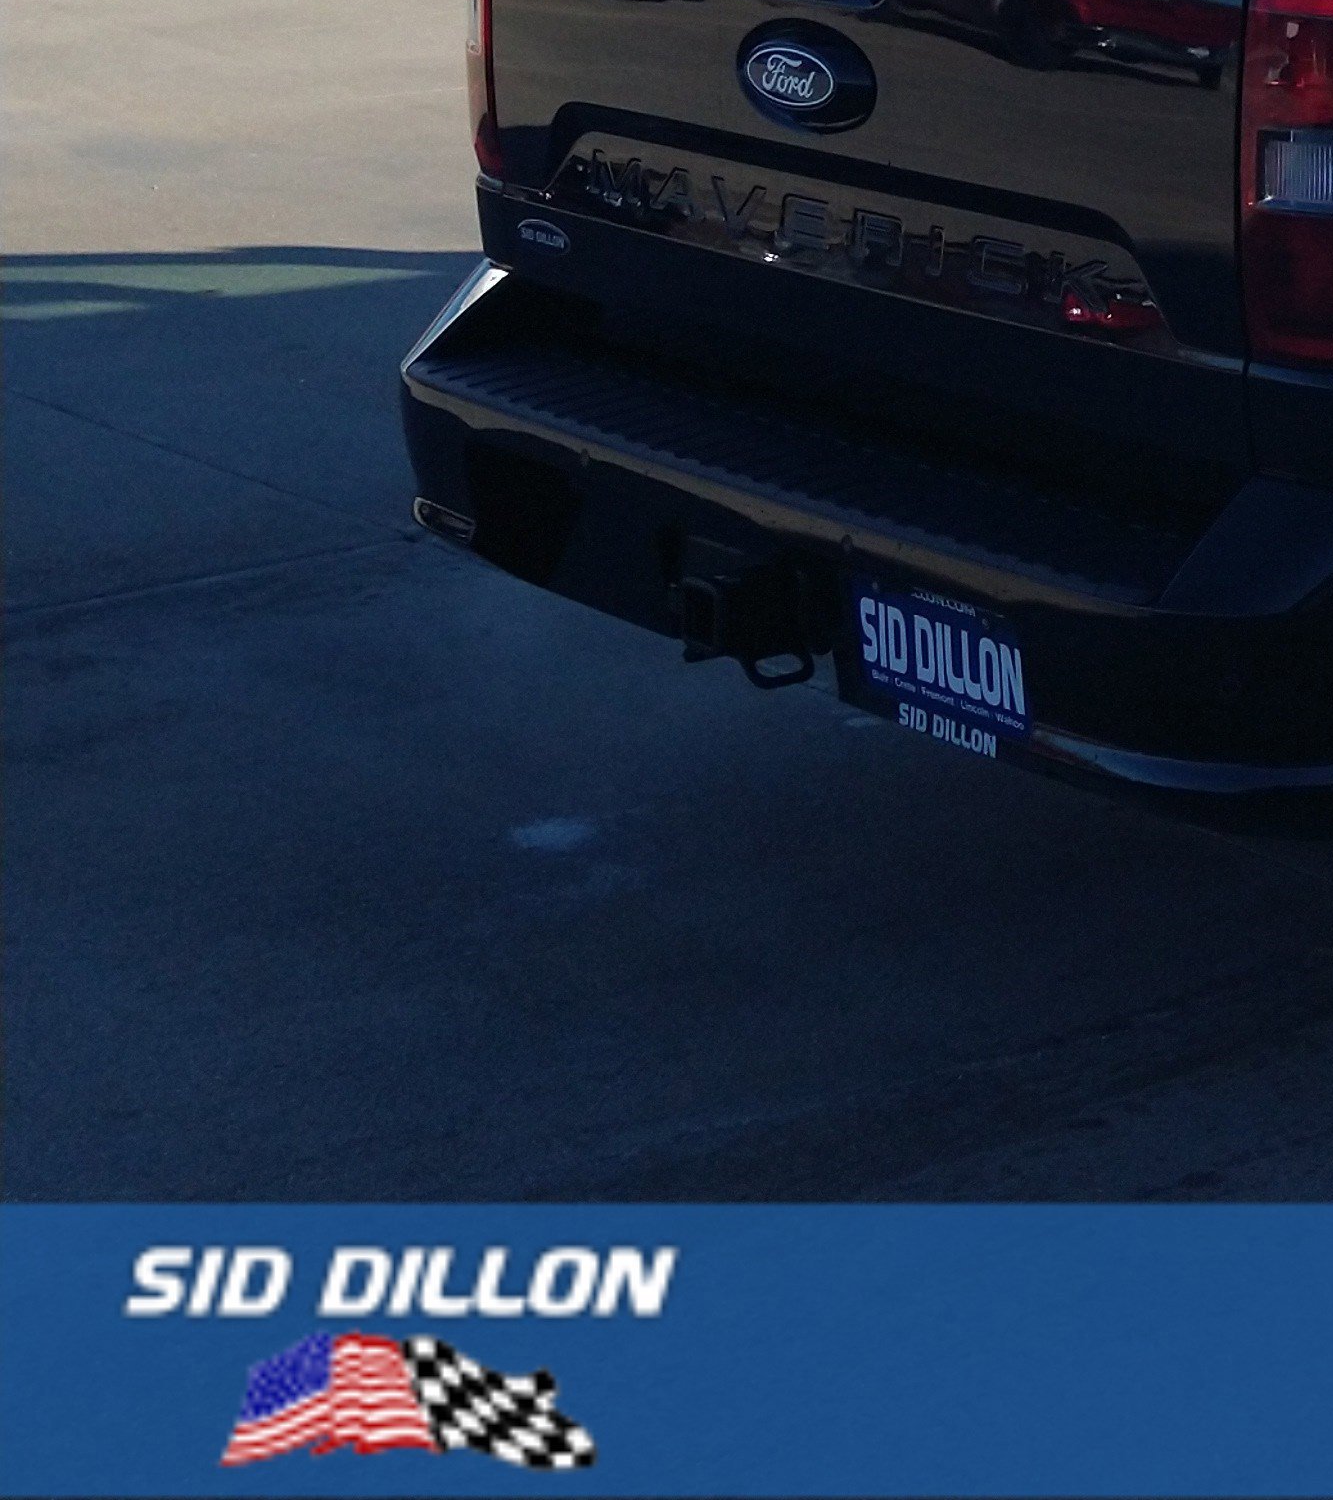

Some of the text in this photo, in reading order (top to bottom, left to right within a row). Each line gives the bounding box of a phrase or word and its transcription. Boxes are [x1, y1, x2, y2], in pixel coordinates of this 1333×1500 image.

[762, 54, 815, 99] Ford
[587, 148, 1110, 315] MAVERICK
[859, 596, 1026, 715] SID DILLON
[898, 702, 997, 759] SID DILLON
